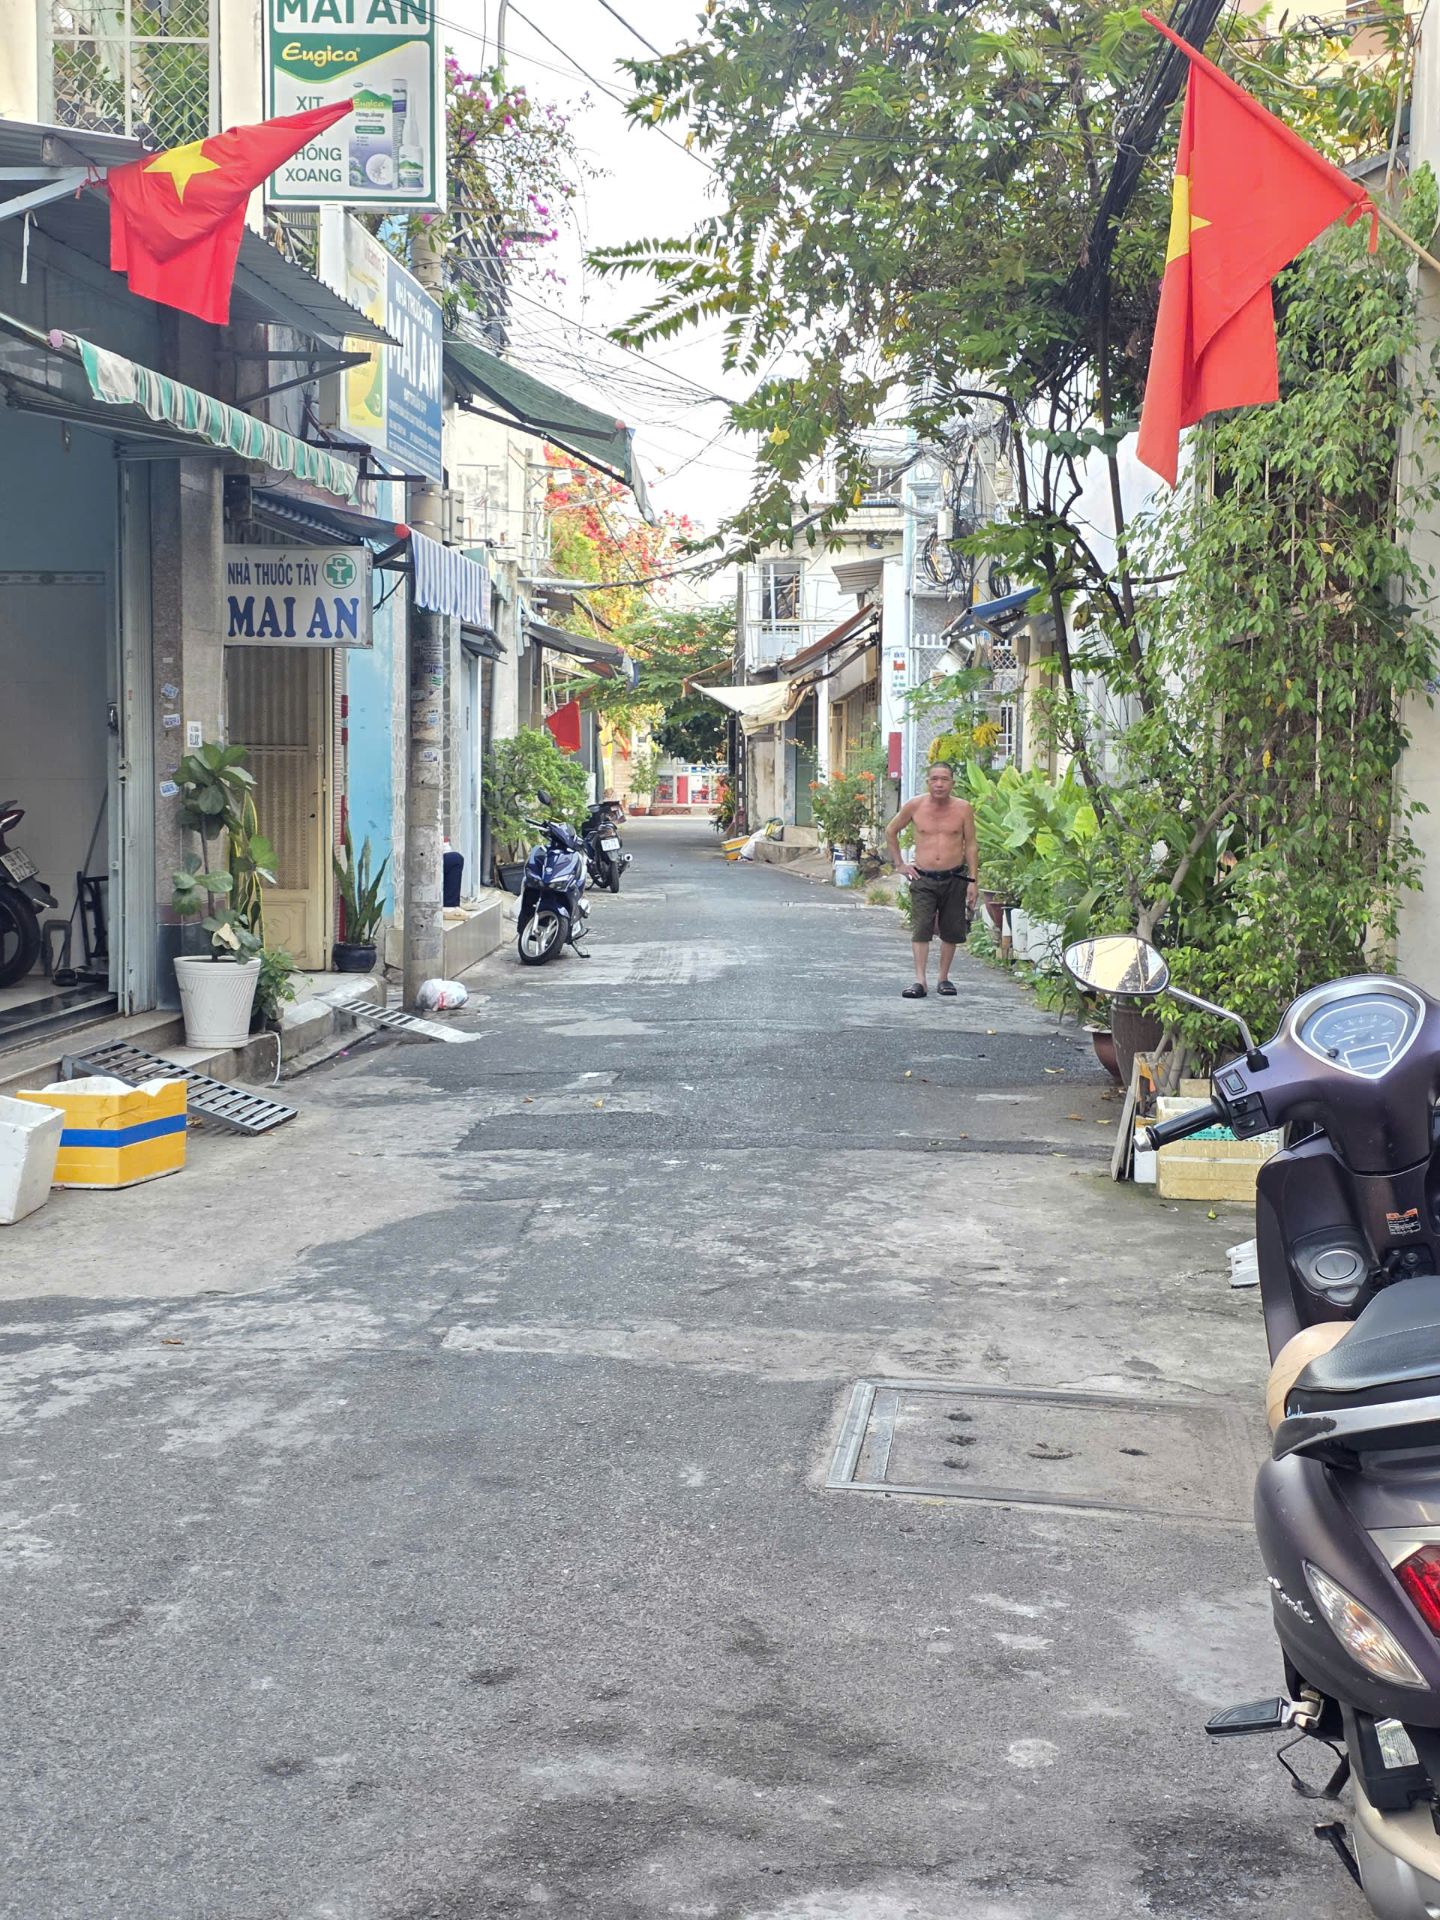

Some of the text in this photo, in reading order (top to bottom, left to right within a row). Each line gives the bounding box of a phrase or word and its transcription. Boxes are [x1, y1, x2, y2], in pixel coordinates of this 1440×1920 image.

[276, 0, 428, 24] MAI AN
[281, 42, 360, 67] Eugica
[295, 143, 342, 161] HÔNG
[285, 168, 342, 182] XOANG
[388, 301, 416, 387] MAI
[418, 339, 439, 403] AN
[227, 555, 318, 585] NHÀ THUỐC TÂY
[227, 596, 359, 639] MAI AN
